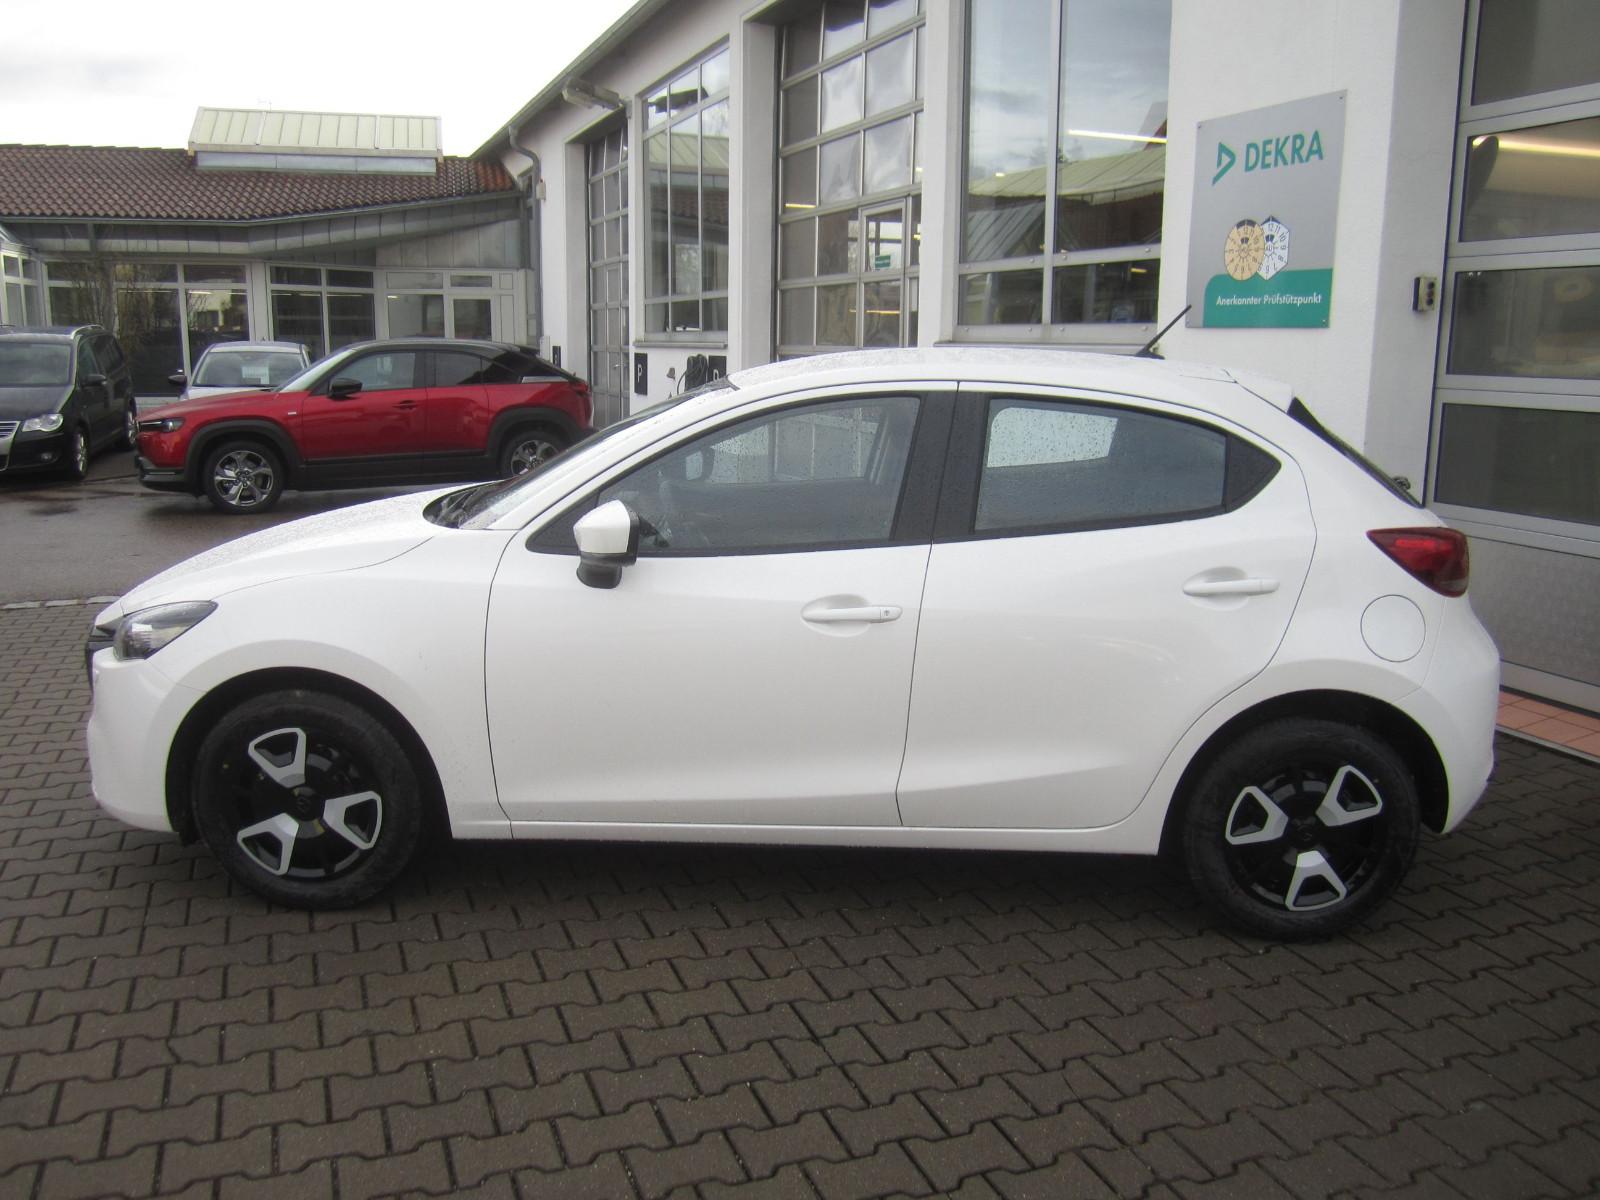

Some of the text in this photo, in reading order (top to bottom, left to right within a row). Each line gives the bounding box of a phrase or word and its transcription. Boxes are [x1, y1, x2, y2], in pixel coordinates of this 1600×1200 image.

[1244, 130, 1323, 172] DEKRA
[1216, 293, 1321, 307] Anerkannter Prüfstützpunkt
